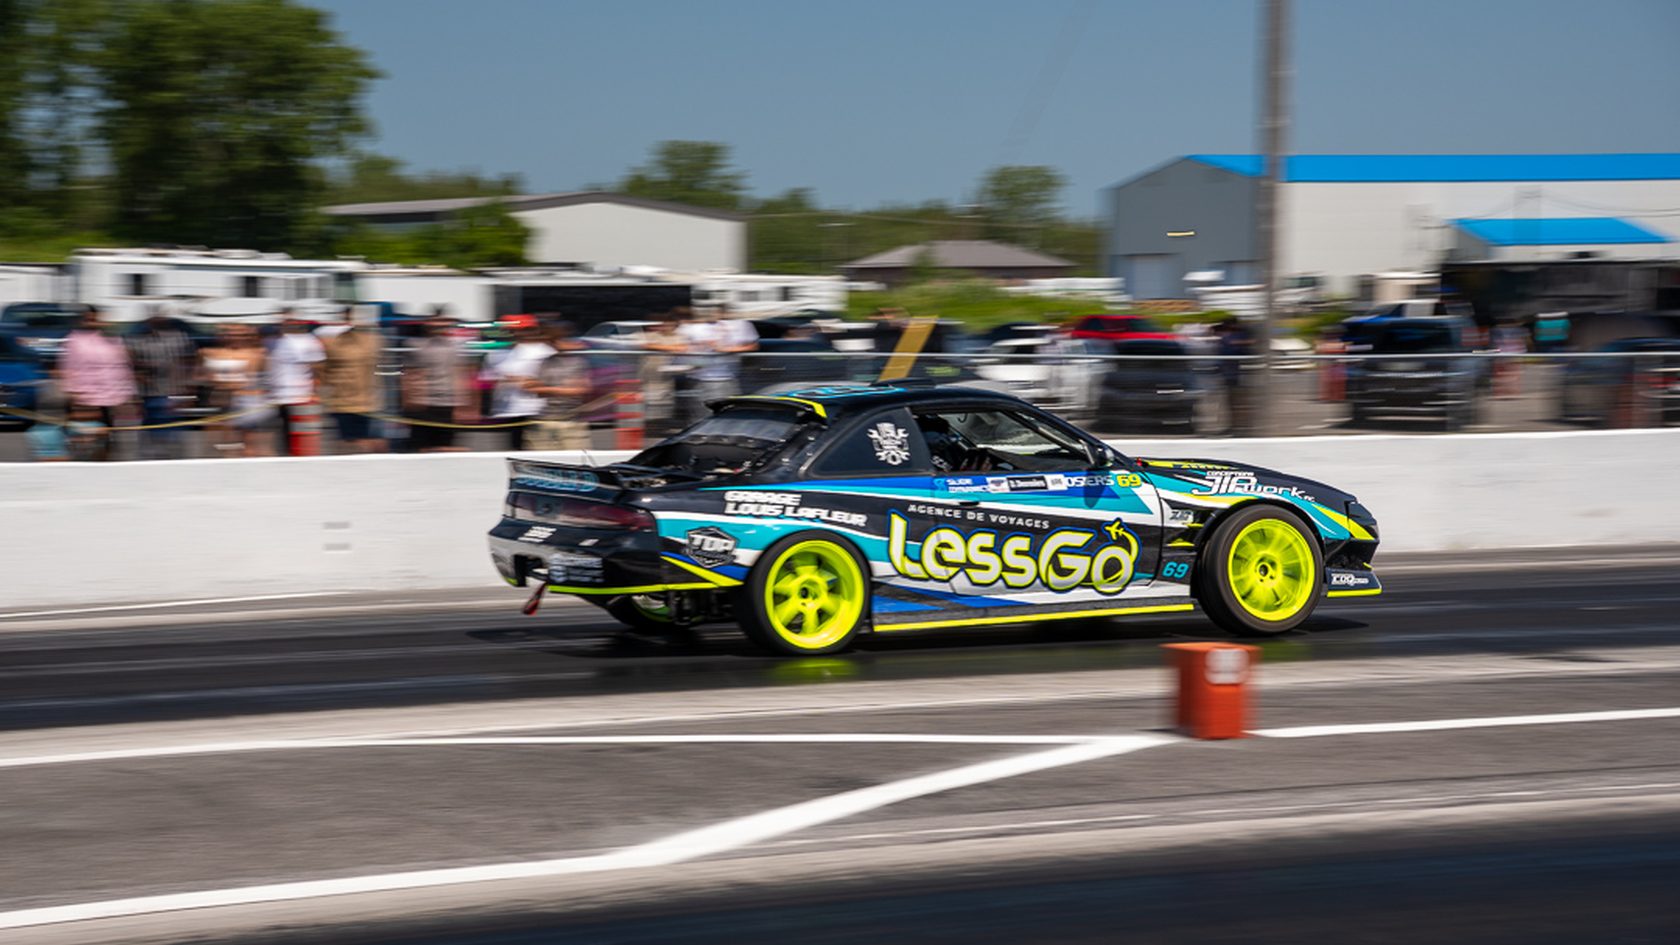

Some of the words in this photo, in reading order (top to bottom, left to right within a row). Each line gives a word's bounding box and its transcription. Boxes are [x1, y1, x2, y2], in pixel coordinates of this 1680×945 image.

[1117, 474, 1141, 488] 69
[724, 490, 802, 506] GARAGE
[724, 502, 784, 516] LOUIS
[784, 506, 868, 527] LAFLEUR
[908, 504, 962, 519] AGENCE
[966, 511, 985, 522] DE
[989, 514, 1050, 529] VOYAGES
[1162, 561, 1189, 579] 69
